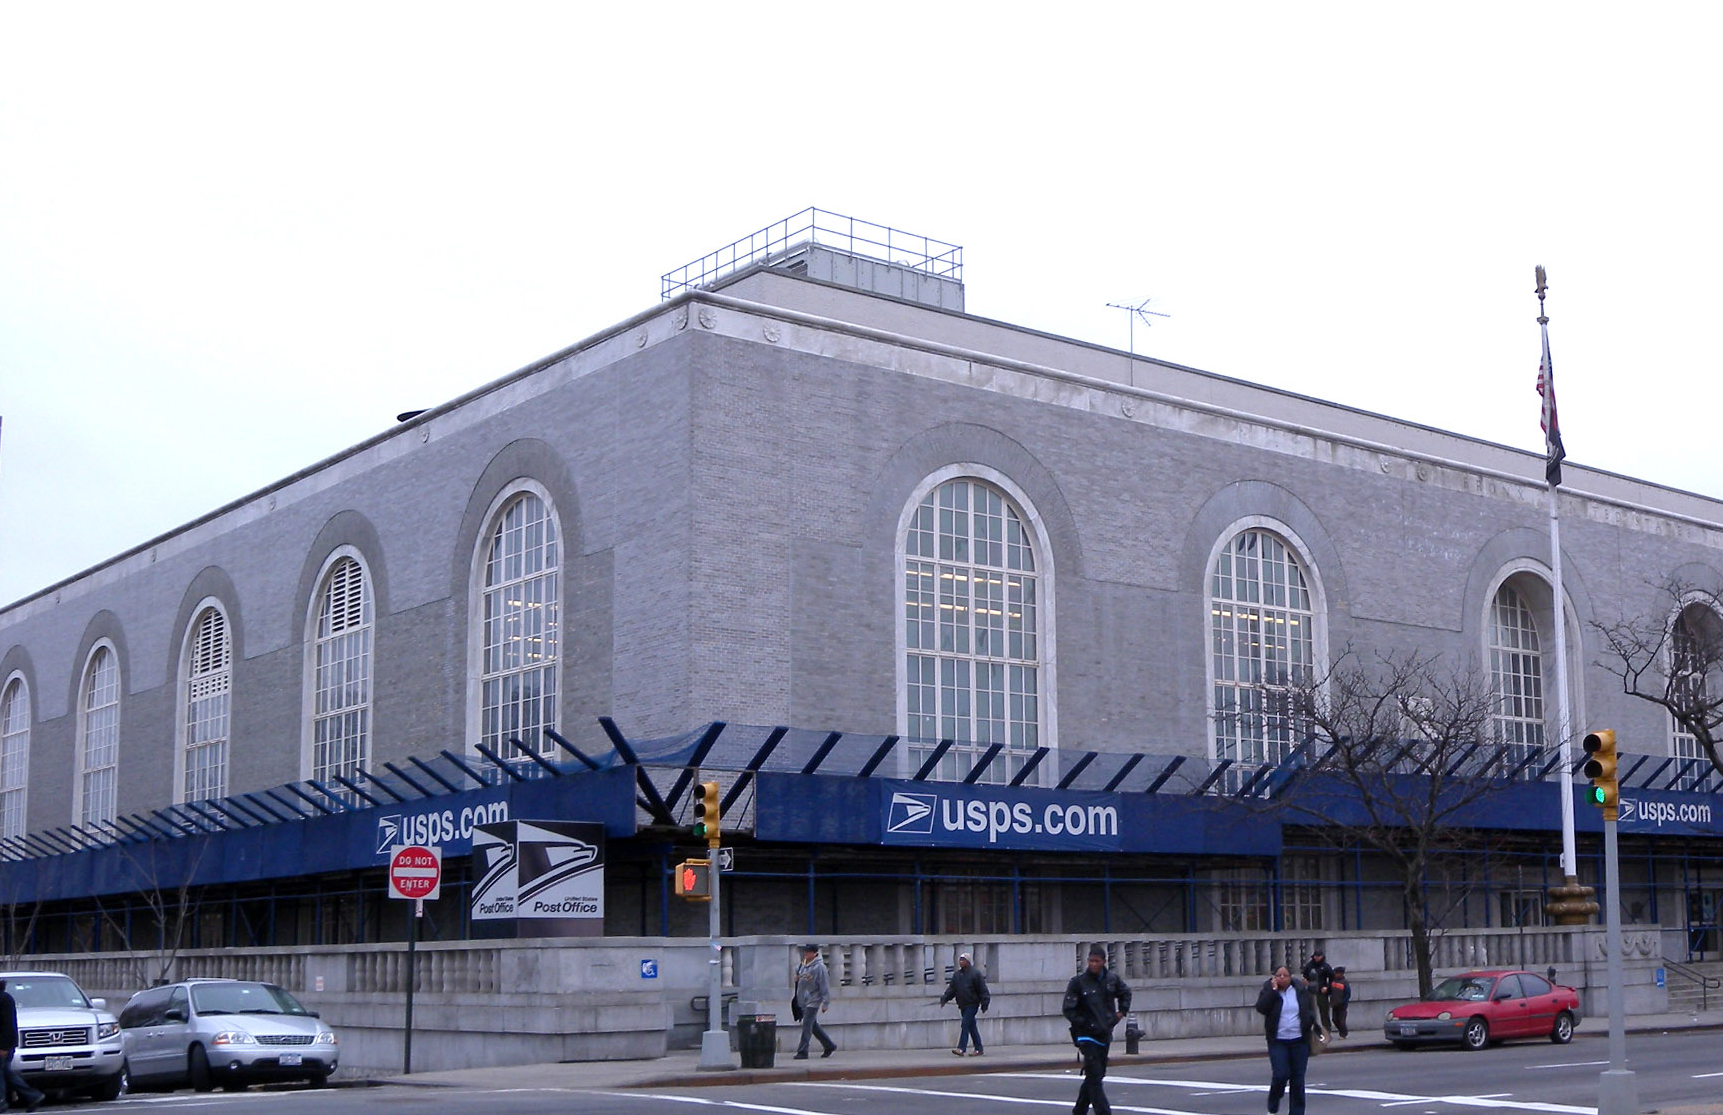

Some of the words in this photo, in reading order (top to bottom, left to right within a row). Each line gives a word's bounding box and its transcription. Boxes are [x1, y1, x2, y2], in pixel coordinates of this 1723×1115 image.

[1638, 801, 1711, 827] usps.com
[402, 800, 509, 846] usps.com
[942, 799, 1118, 843] usps.com
[399, 856, 412, 865] DO
[414, 856, 432, 865] NOT
[400, 880, 430, 889] ENTER
[480, 902, 495, 914] Post
[494, 902, 514, 913] Office
[533, 901, 561, 913] Post
[562, 901, 598, 913] Office
